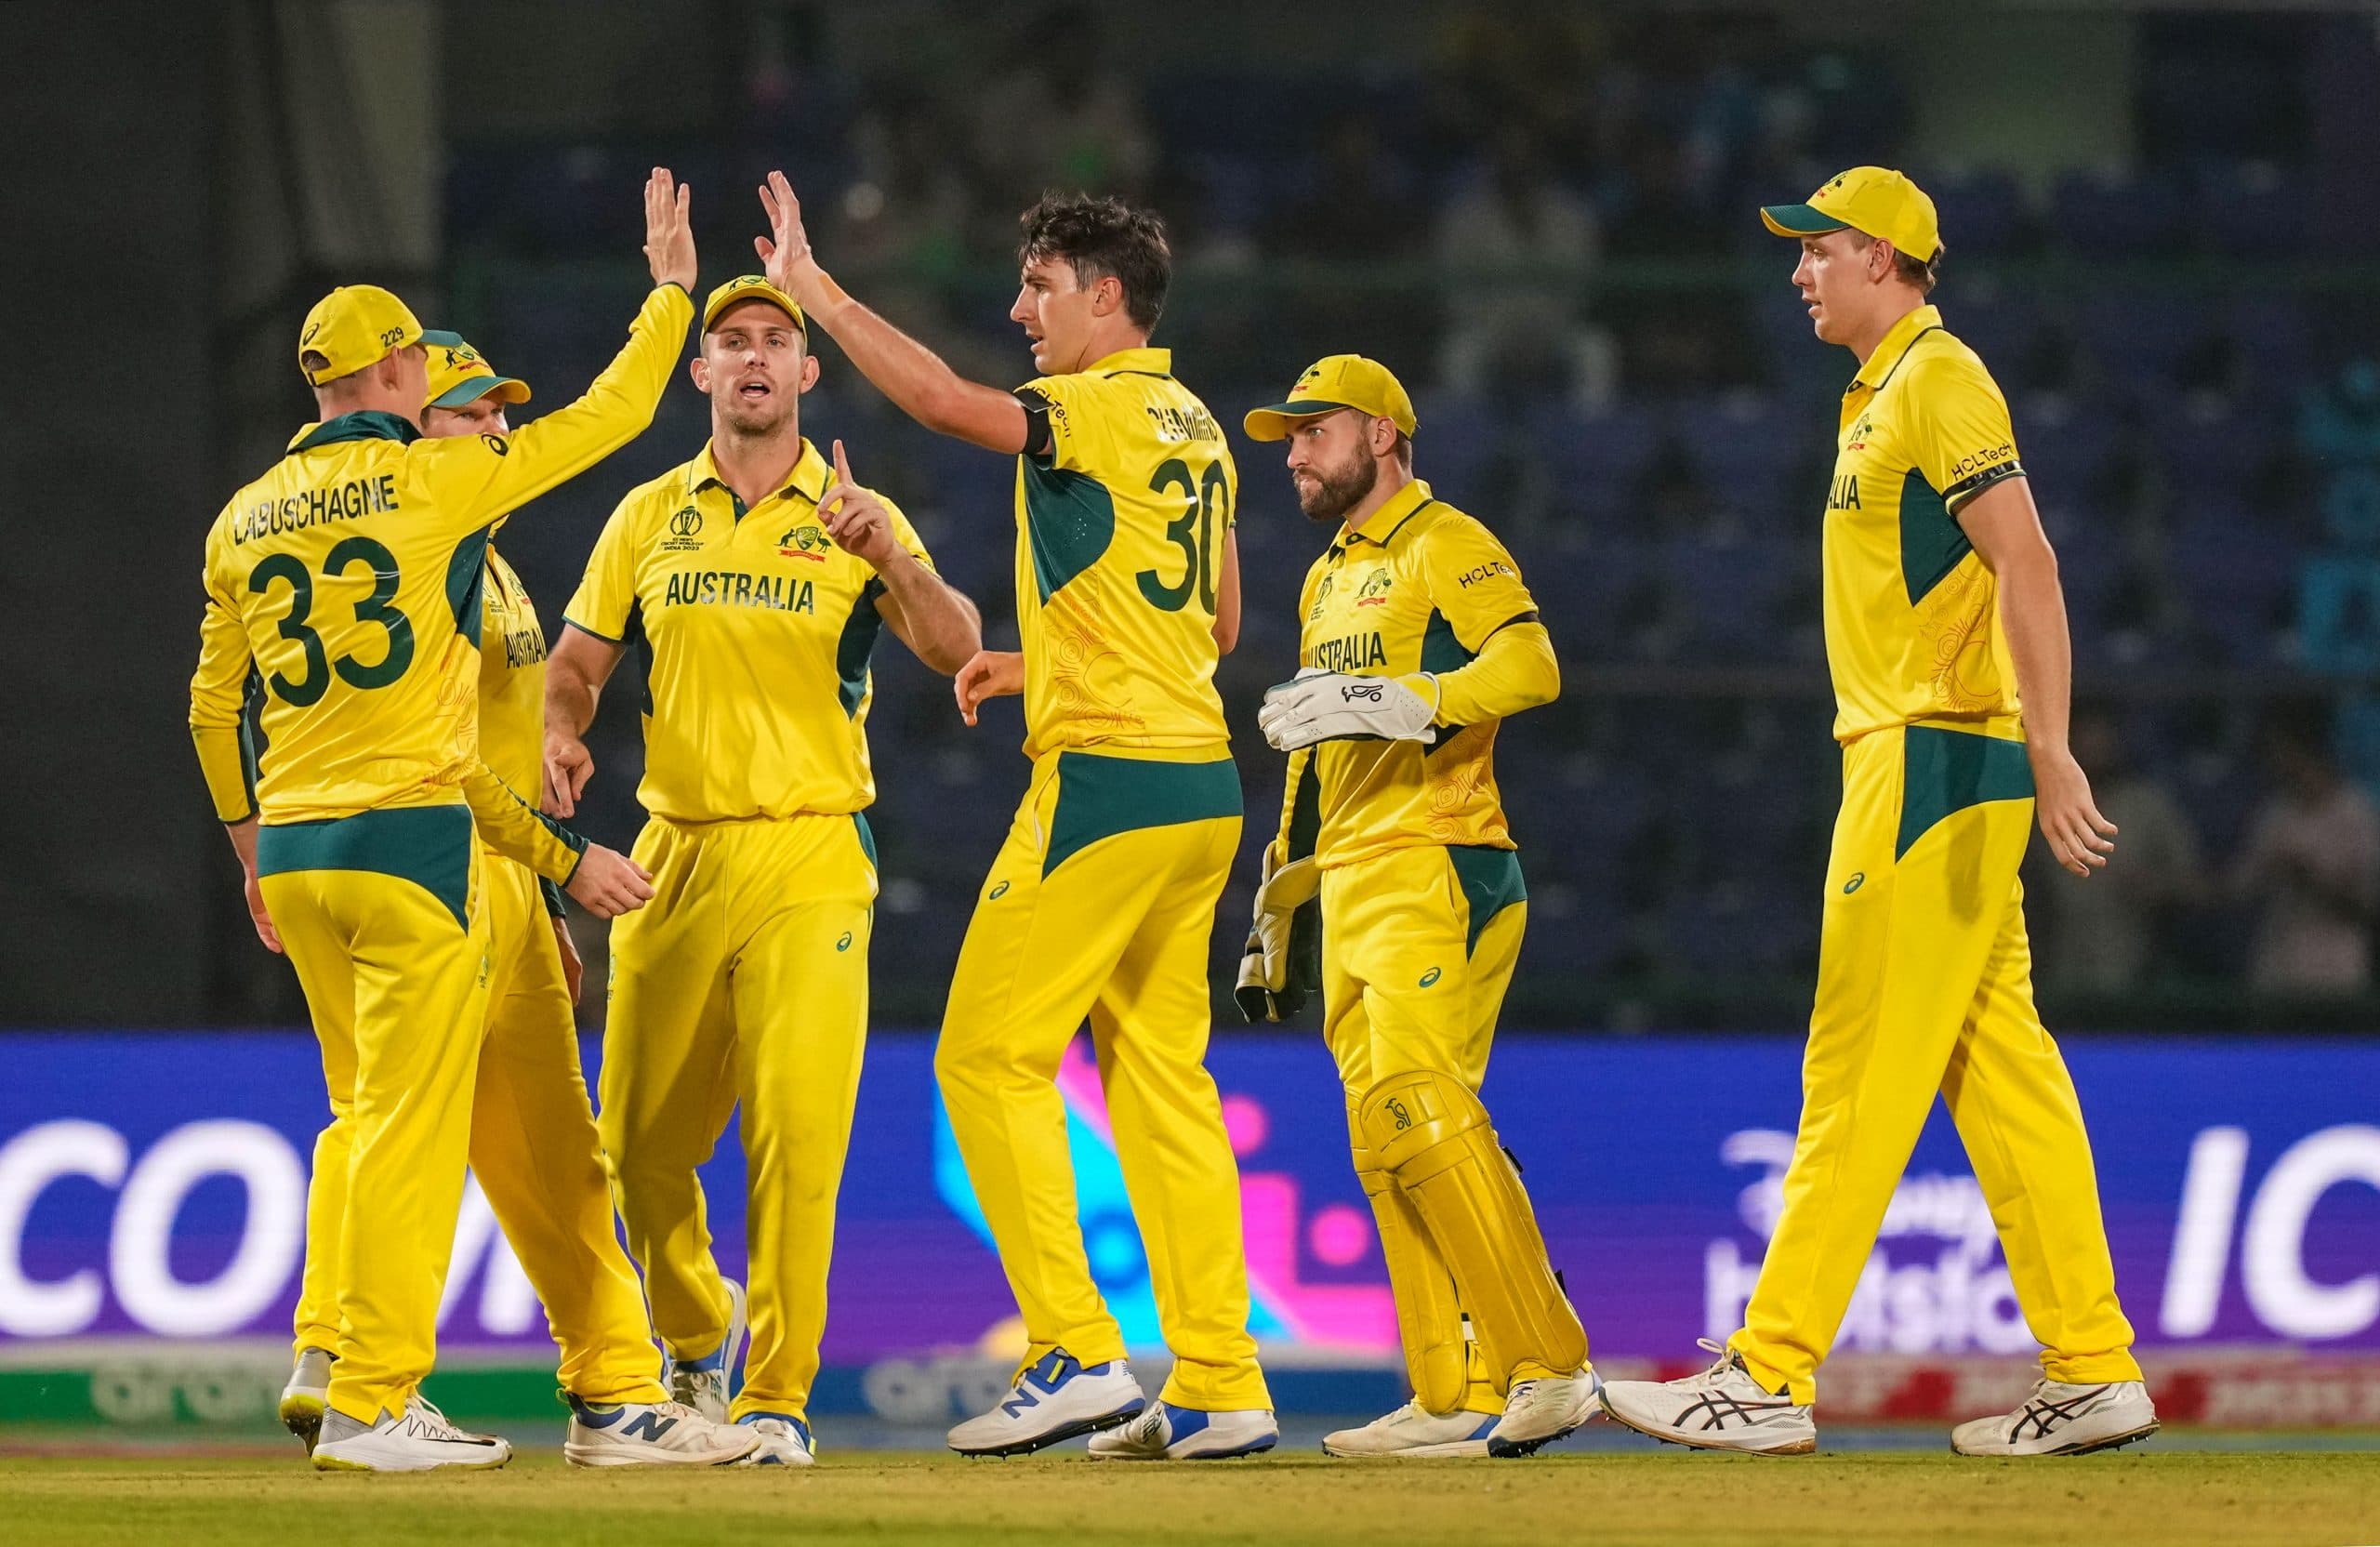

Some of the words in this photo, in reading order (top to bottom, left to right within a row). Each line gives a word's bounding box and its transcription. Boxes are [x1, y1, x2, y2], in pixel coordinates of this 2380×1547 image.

[380, 327, 404, 348] 229
[234, 474, 399, 546] LABUSCHAGNE
[1136, 458, 1229, 615] 30
[666, 571, 813, 615] AUSTRALIA
[1459, 562, 1513, 589] HCLTe
[248, 536, 415, 707] 33
[2158, 1125, 2380, 1340] IC
